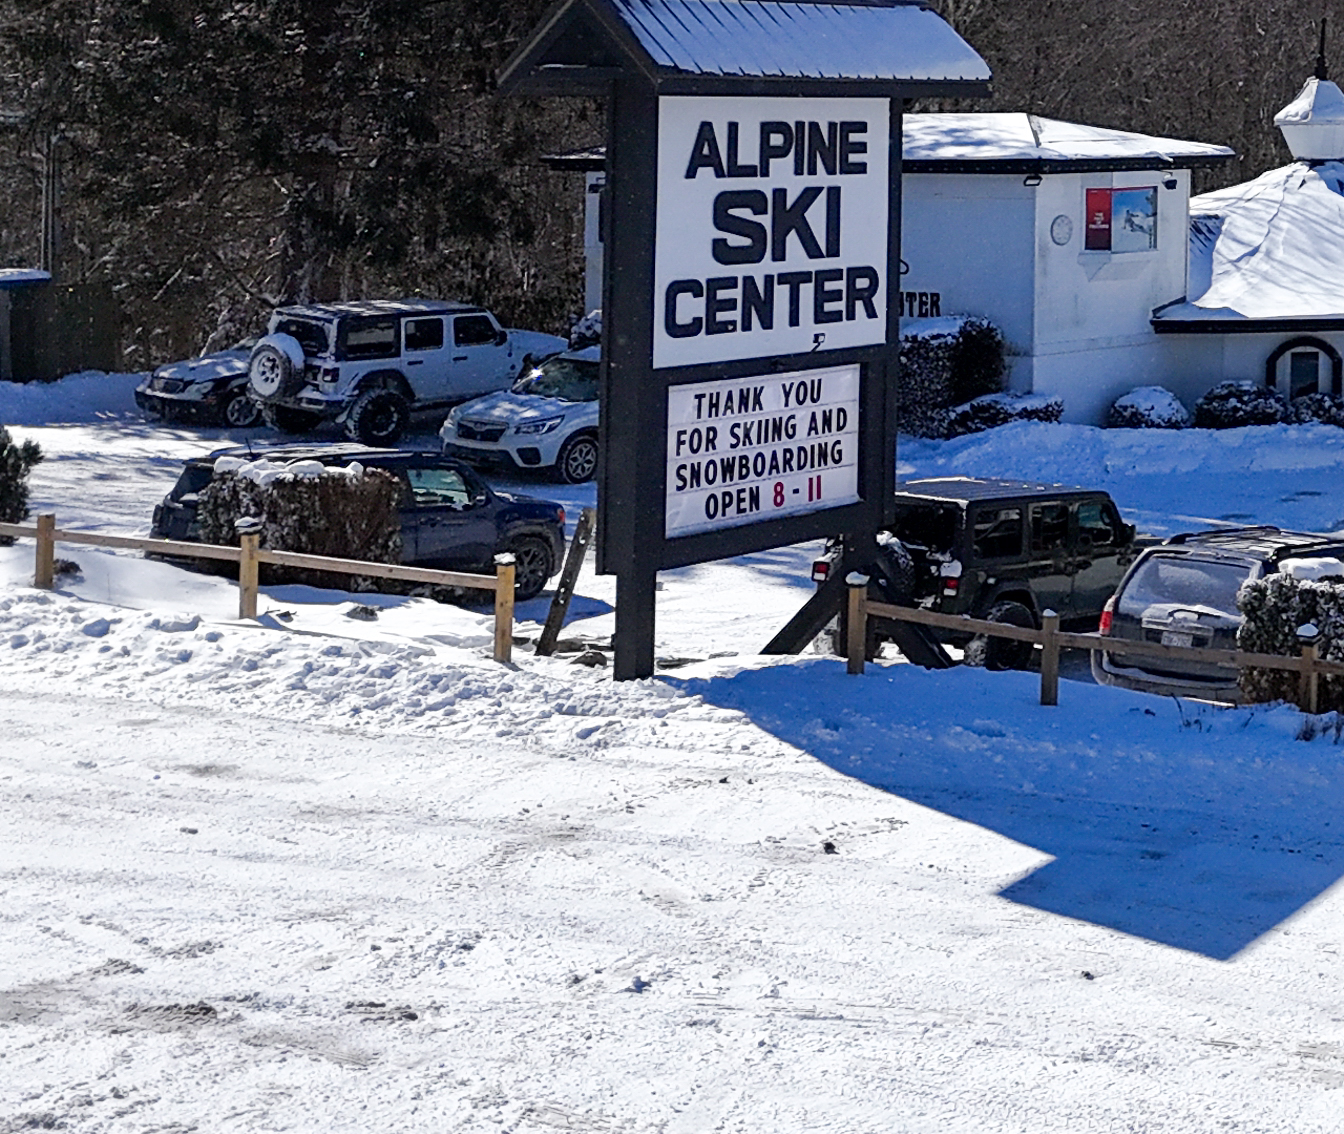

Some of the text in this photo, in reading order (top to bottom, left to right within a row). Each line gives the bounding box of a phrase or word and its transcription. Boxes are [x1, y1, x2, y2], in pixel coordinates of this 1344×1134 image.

[684, 121, 868, 179] ALPINE
[711, 186, 842, 266] SKI
[664, 265, 880, 339] CENTER
[694, 378, 822, 419] THANK YOU
[675, 407, 847, 456] FOR SKIING AND
[675, 439, 843, 492] SNOWBOARDING
[705, 485, 760, 520] OPEN
[773, 481, 785, 507] 8
